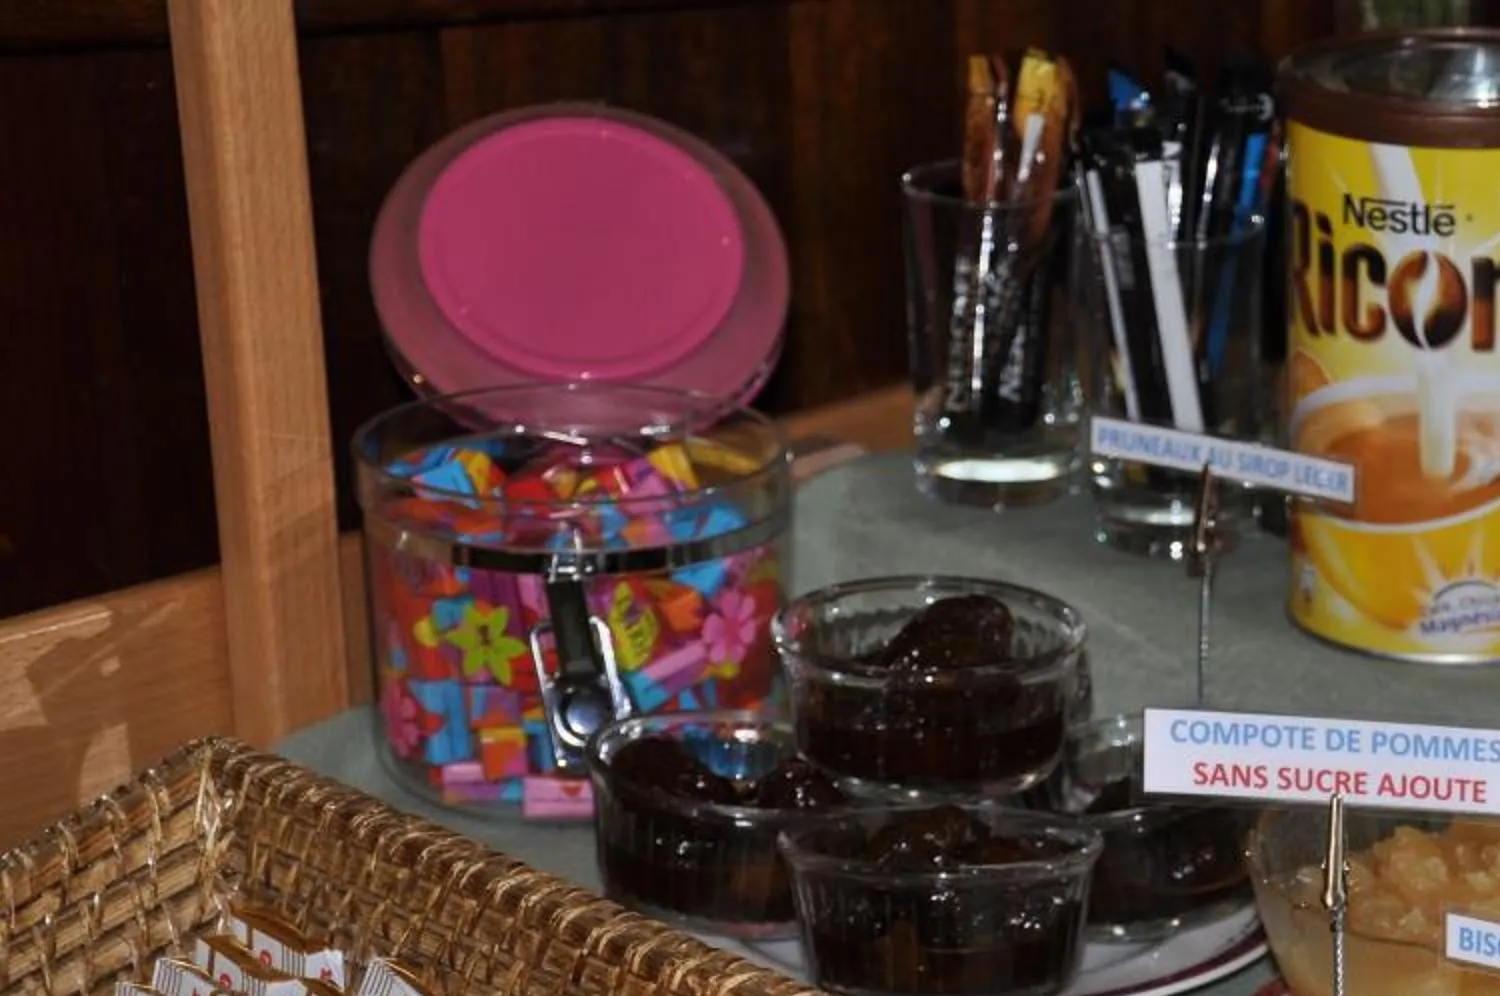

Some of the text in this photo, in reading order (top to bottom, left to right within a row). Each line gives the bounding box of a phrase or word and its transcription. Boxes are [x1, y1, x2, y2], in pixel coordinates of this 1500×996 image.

[1343, 193, 1457, 237] Nestlé
[1239, 452, 1289, 479] SIROP
[1169, 718, 1317, 752] COMPOTE
[1325, 728, 1362, 754] DE
[1192, 761, 1488, 805] SANS SUCRE AJOUTE
